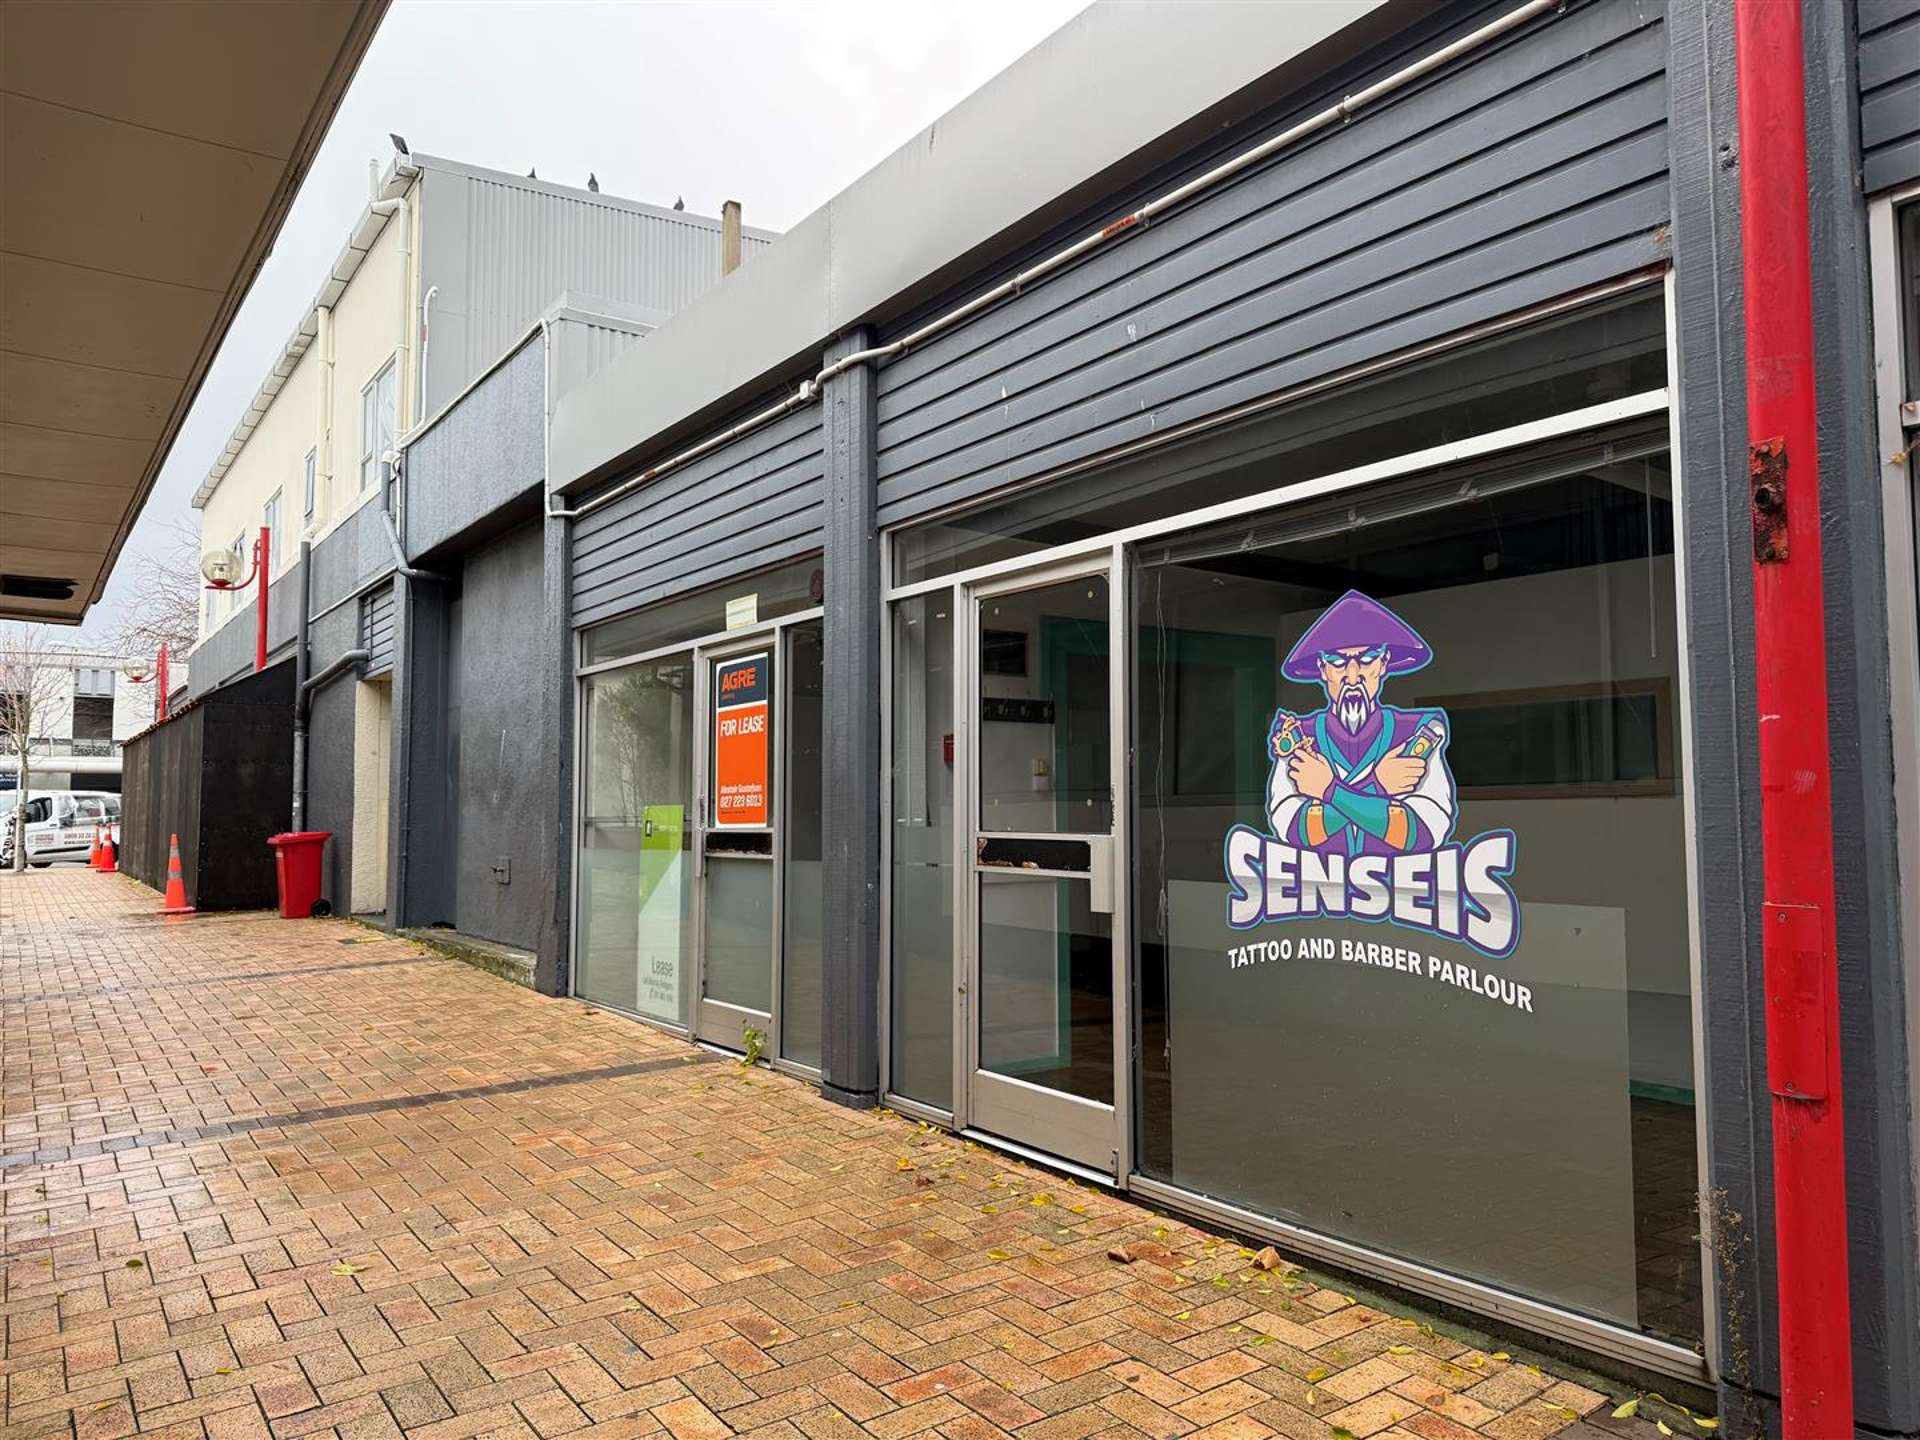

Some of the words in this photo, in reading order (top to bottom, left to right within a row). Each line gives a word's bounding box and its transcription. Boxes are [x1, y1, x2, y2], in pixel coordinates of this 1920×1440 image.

[722, 667, 756, 692] AGRE
[720, 719, 737, 737] FOR
[738, 715, 765, 735] LEASE
[1225, 826, 1518, 956] SENSEIS
[651, 955, 673, 978] Lease
[1228, 939, 1292, 969] TATTOO
[1298, 938, 1335, 960] AND
[1341, 939, 1423, 975] BARBER
[1428, 955, 1534, 1013] PARLOUR
